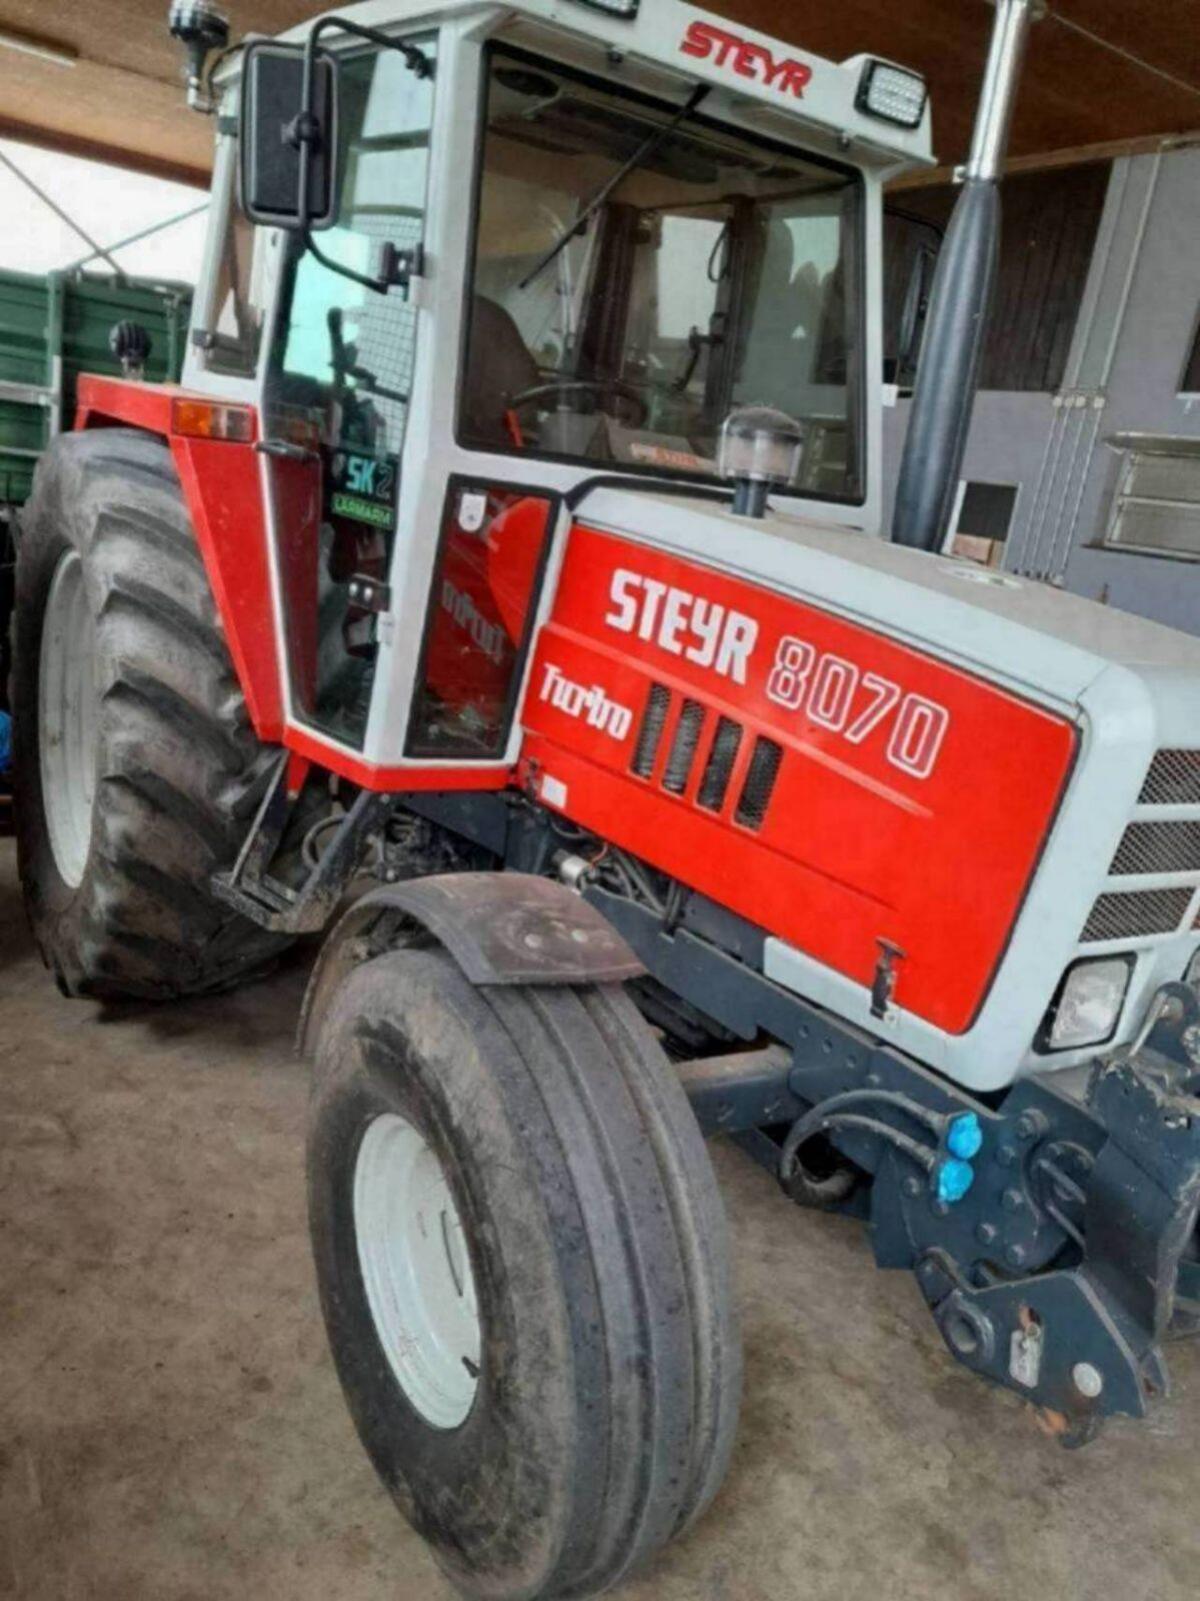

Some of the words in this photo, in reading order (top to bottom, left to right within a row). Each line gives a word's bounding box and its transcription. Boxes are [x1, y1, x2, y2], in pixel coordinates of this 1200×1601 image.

[680, 21, 812, 98] STEYR
[539, 663, 632, 741] Turbo
[605, 568, 759, 686] STEYR
[766, 635, 949, 779] 8070
